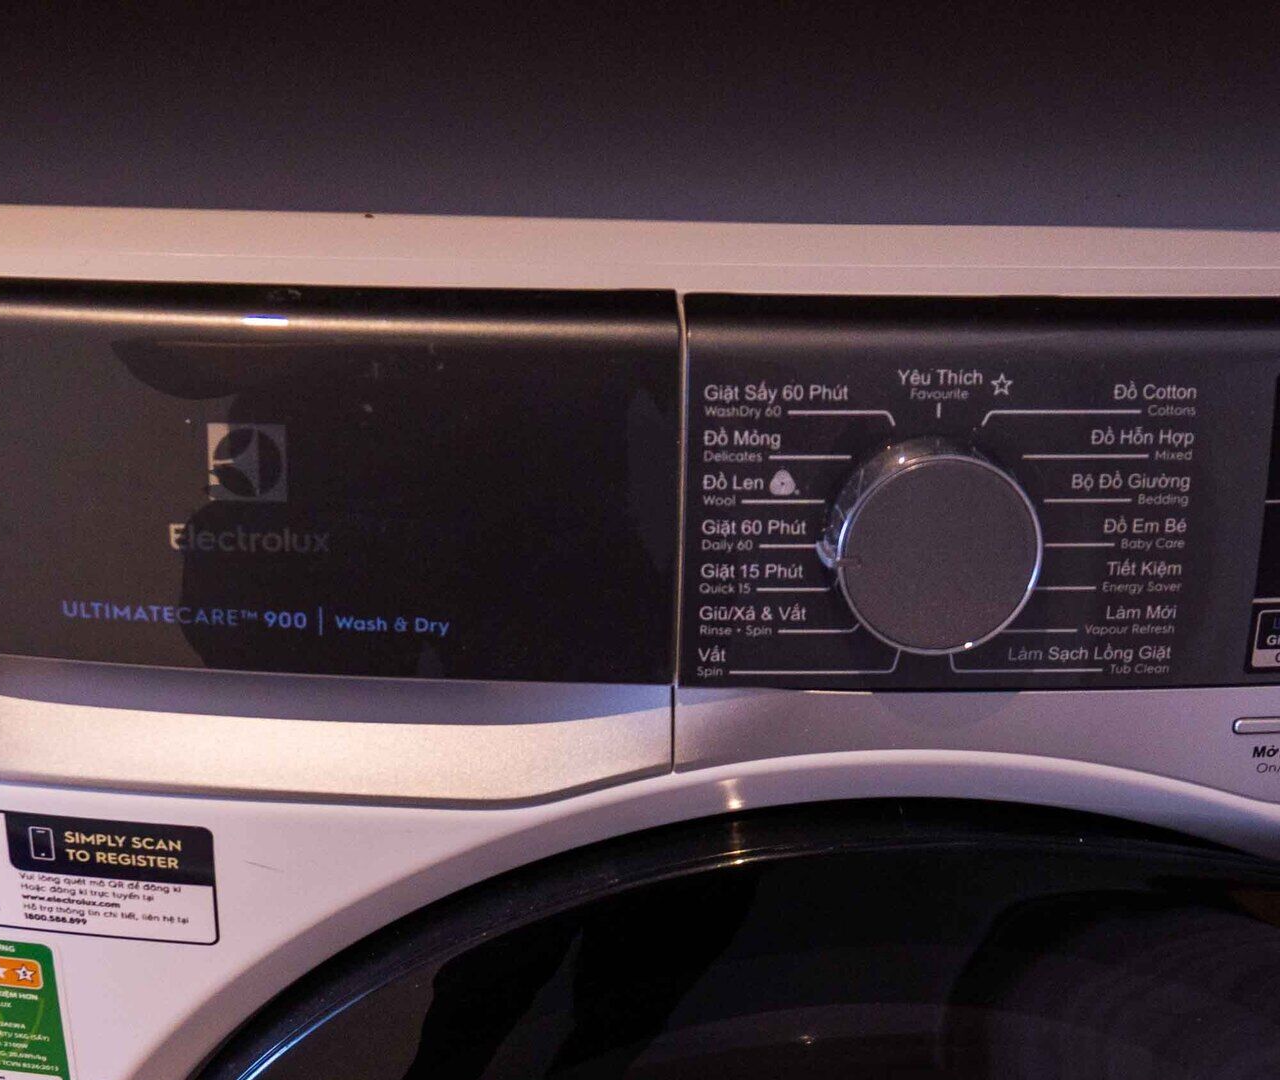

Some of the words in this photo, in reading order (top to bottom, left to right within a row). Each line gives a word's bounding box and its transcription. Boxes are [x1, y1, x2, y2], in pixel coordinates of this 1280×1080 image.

[898, 368, 931, 386] Yêu
[936, 368, 983, 386] Thích
[704, 384, 739, 403] Giặt
[745, 381, 777, 403] Sấy
[782, 384, 804, 400] 60
[810, 384, 849, 400] Phút
[910, 388, 969, 400] Favourite
[1114, 380, 1137, 399] Đồ
[1143, 384, 1197, 399] Cotton
[704, 406, 761, 420] WashDry
[765, 406, 782, 418] 60
[1147, 405, 1197, 416] Cottons
[703, 426, 728, 446] Đồ
[733, 429, 782, 450] Mỏng
[1090, 426, 1115, 445] Đồ
[1120, 424, 1154, 445] Hỗn
[1158, 430, 1195, 449] Hợp
[704, 450, 763, 463] Delicates
[1154, 450, 1193, 461] Mixed
[702, 470, 728, 490] Đồ
[733, 474, 764, 490] Len
[1071, 474, 1094, 492] Bộ
[1098, 470, 1124, 489] Đồ
[1128, 471, 1191, 491] Giường
[703, 494, 736, 506] Wool
[1137, 493, 1189, 507] Bedding
[701, 519, 737, 537] Giặt
[741, 519, 762, 535] 60
[768, 519, 806, 535] Phút
[1103, 515, 1127, 534] Đồ
[1132, 519, 1159, 533] Em
[1165, 517, 1187, 533] Bé
[169, 522, 330, 555] Electrolux
[702, 540, 732, 552] Daily
[736, 540, 753, 550] 60
[1120, 538, 1152, 551] Baby
[1156, 538, 1185, 549] Care
[700, 563, 735, 580] Giặt
[741, 564, 760, 578] 15
[764, 563, 803, 578] Phút
[1107, 559, 1136, 576] Tiết
[1141, 561, 1182, 578] Kiệm
[699, 583, 735, 594] Quick
[738, 583, 751, 594] 15
[1102, 582, 1143, 595] Energy
[1147, 582, 1182, 593] Saver
[263, 610, 308, 630] 900
[761, 606, 773, 620] &
[778, 603, 806, 621] Vắt
[1106, 605, 1141, 620] Làm
[1145, 604, 1177, 620] Mới
[334, 614, 388, 633] Wash
[394, 617, 408, 632] &
[414, 617, 450, 637] Dry
[700, 625, 732, 636] Rinse
[745, 625, 772, 637] Spin
[1084, 625, 1128, 637] Vapour
[1132, 624, 1175, 634] Refresh
[697, 645, 726, 662] Vắt
[1007, 645, 1043, 661] Làm
[1048, 645, 1089, 663] Sạch
[1093, 643, 1133, 663] Lồng
[1138, 645, 1172, 662] Giặt
[696, 667, 723, 678] Spin
[1109, 664, 1131, 674] Tub
[1134, 663, 1169, 674] Clean
[64, 830, 126, 850] SIMPLY
[131, 835, 183, 852] SCAN
[65, 848, 92, 864] TO
[96, 852, 180, 870] REGISTER
[108, 880, 124, 889] QR
[21, 893, 121, 909] www.electrolux.com
